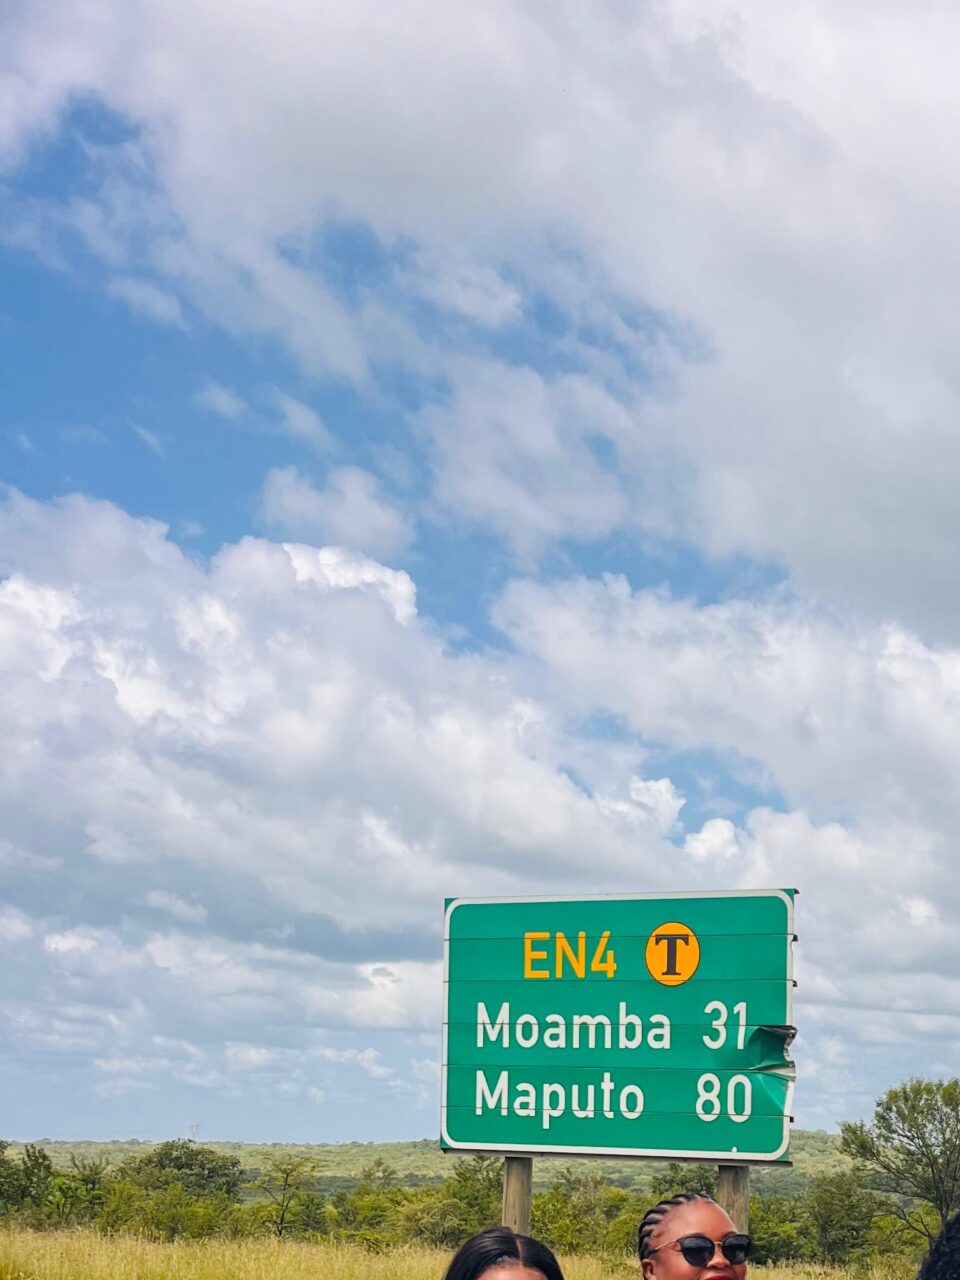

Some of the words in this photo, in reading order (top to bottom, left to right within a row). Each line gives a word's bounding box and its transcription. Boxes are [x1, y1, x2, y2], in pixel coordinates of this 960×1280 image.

[523, 931, 617, 978] EN4
[654, 934, 690, 976] T
[476, 1001, 671, 1049] Moamba
[702, 1001, 748, 1049] 31
[475, 1070, 645, 1129] Maputo
[695, 1073, 752, 1122] 80
